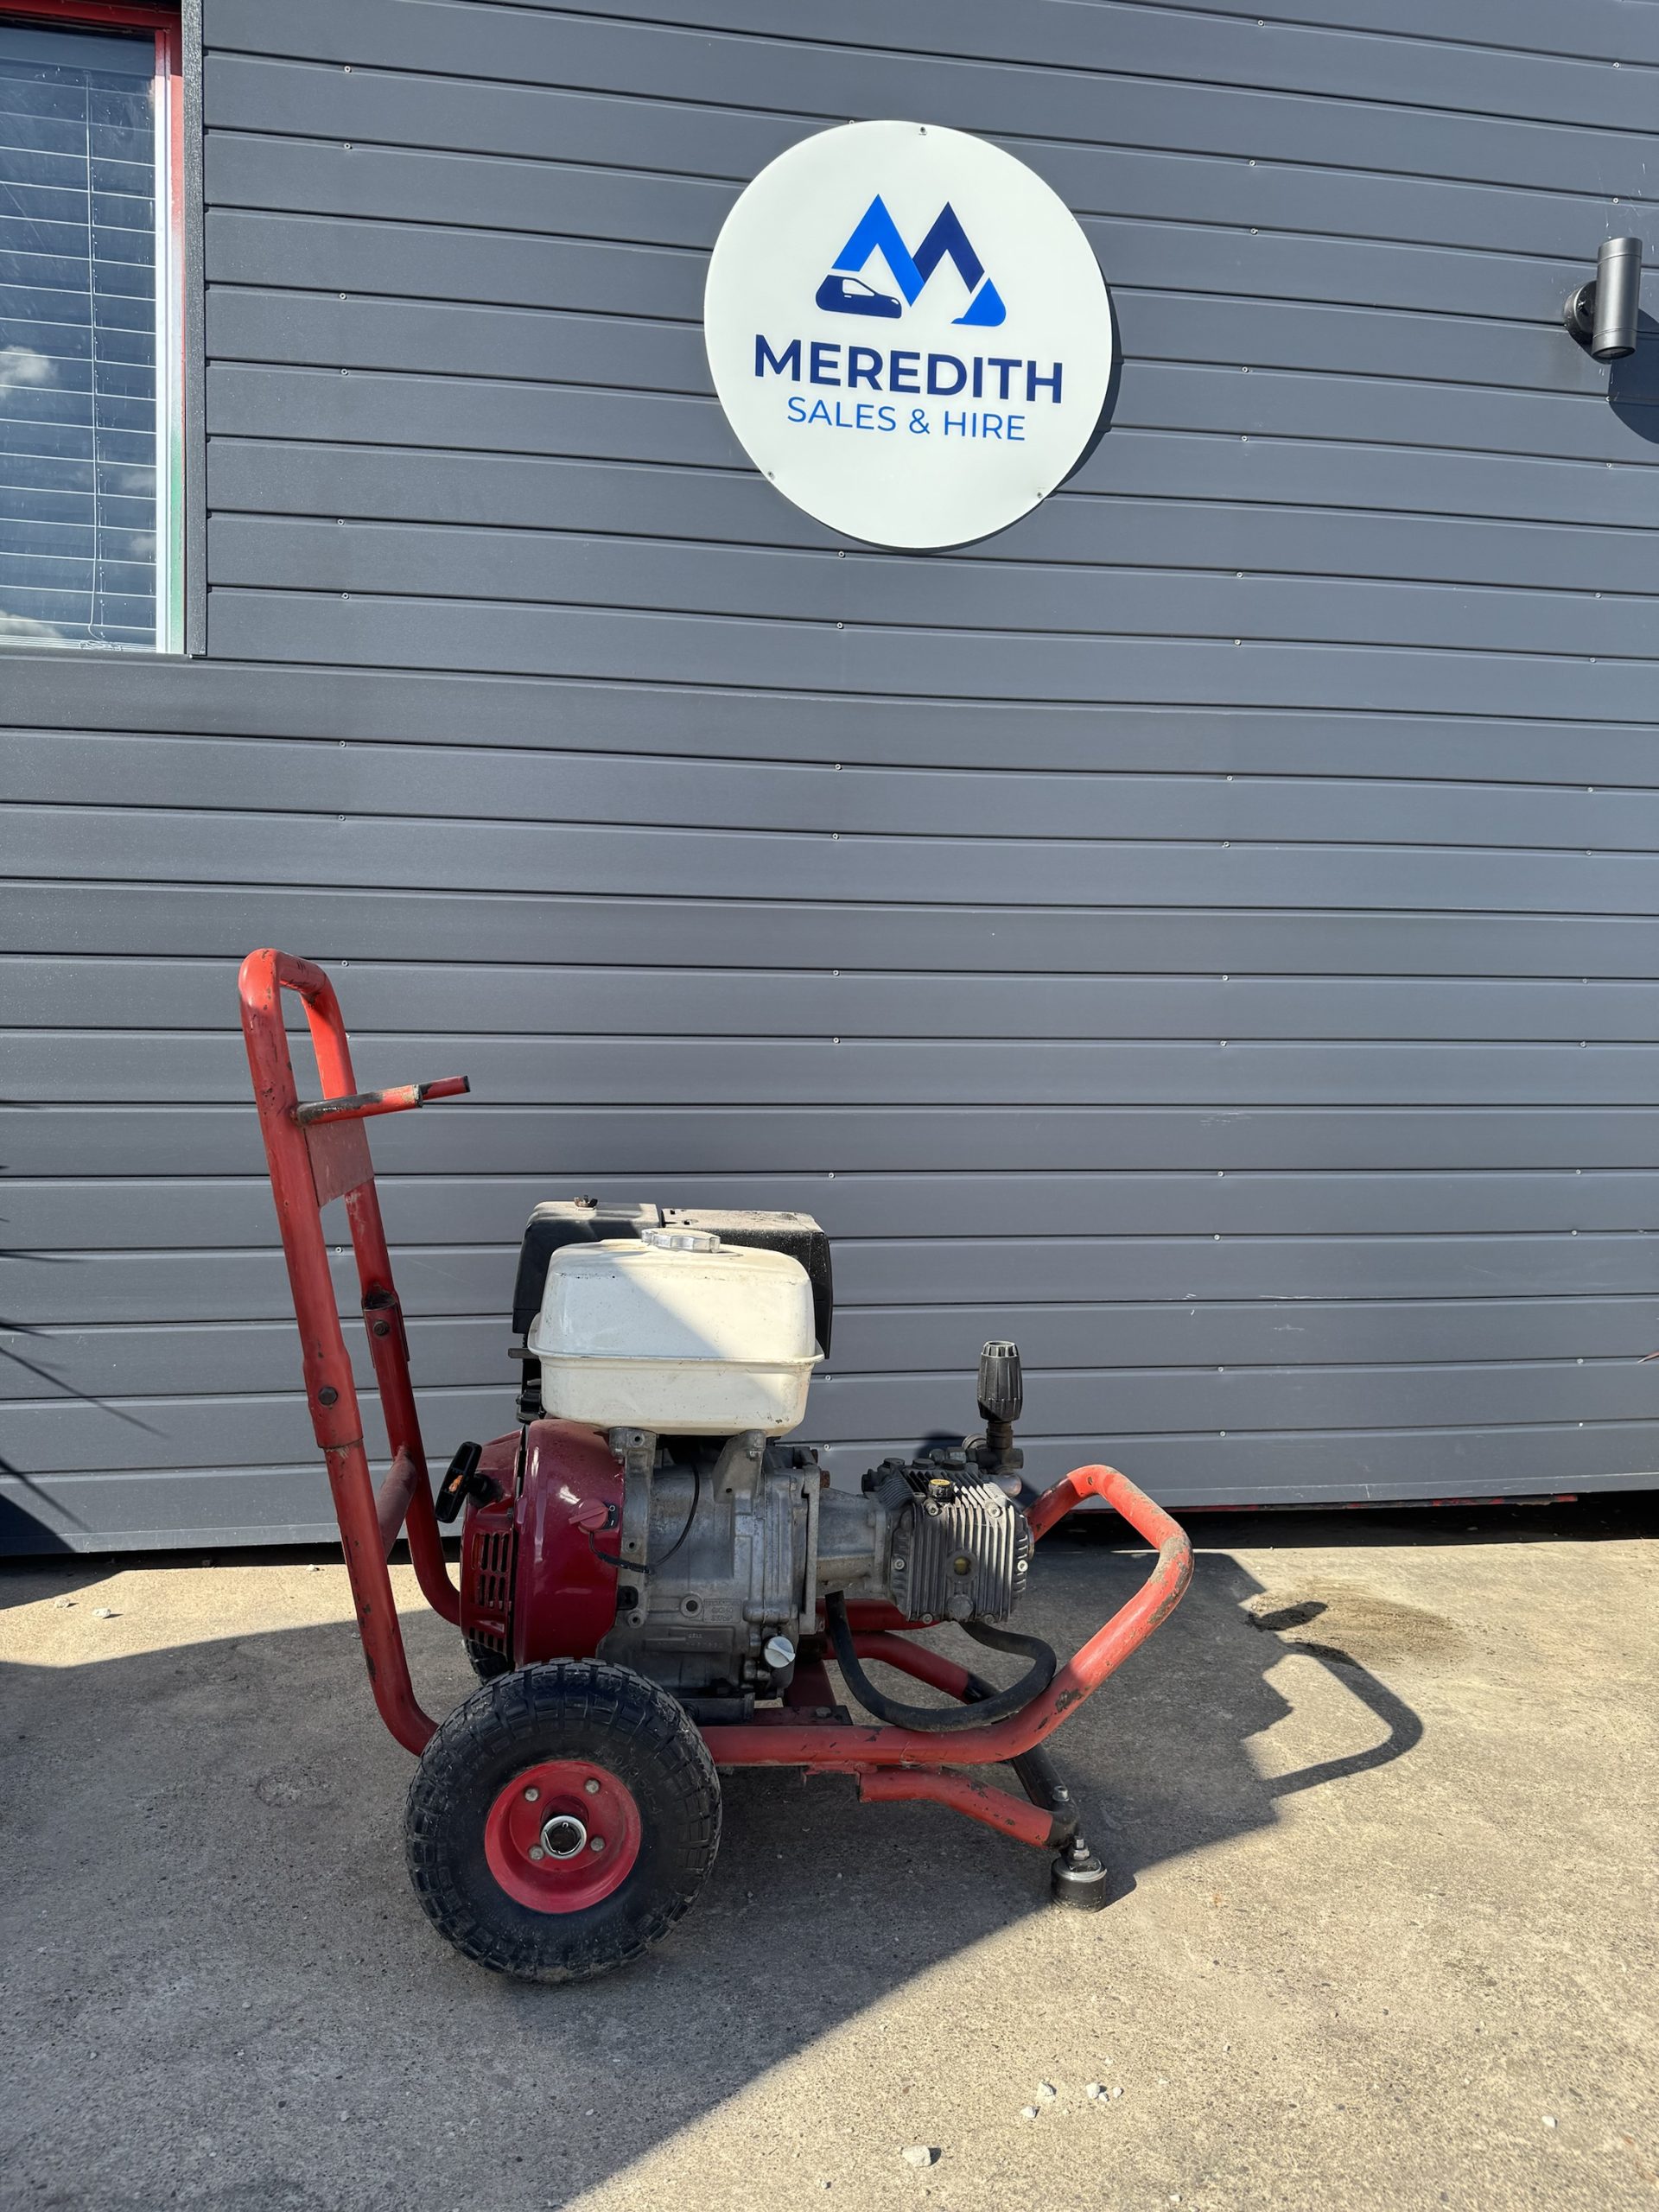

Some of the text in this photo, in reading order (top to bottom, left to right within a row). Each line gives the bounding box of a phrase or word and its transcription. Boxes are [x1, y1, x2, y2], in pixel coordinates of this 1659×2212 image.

[754, 334, 1063, 404] MEREDITH
[787, 396, 1026, 442] SALES & HIRE
